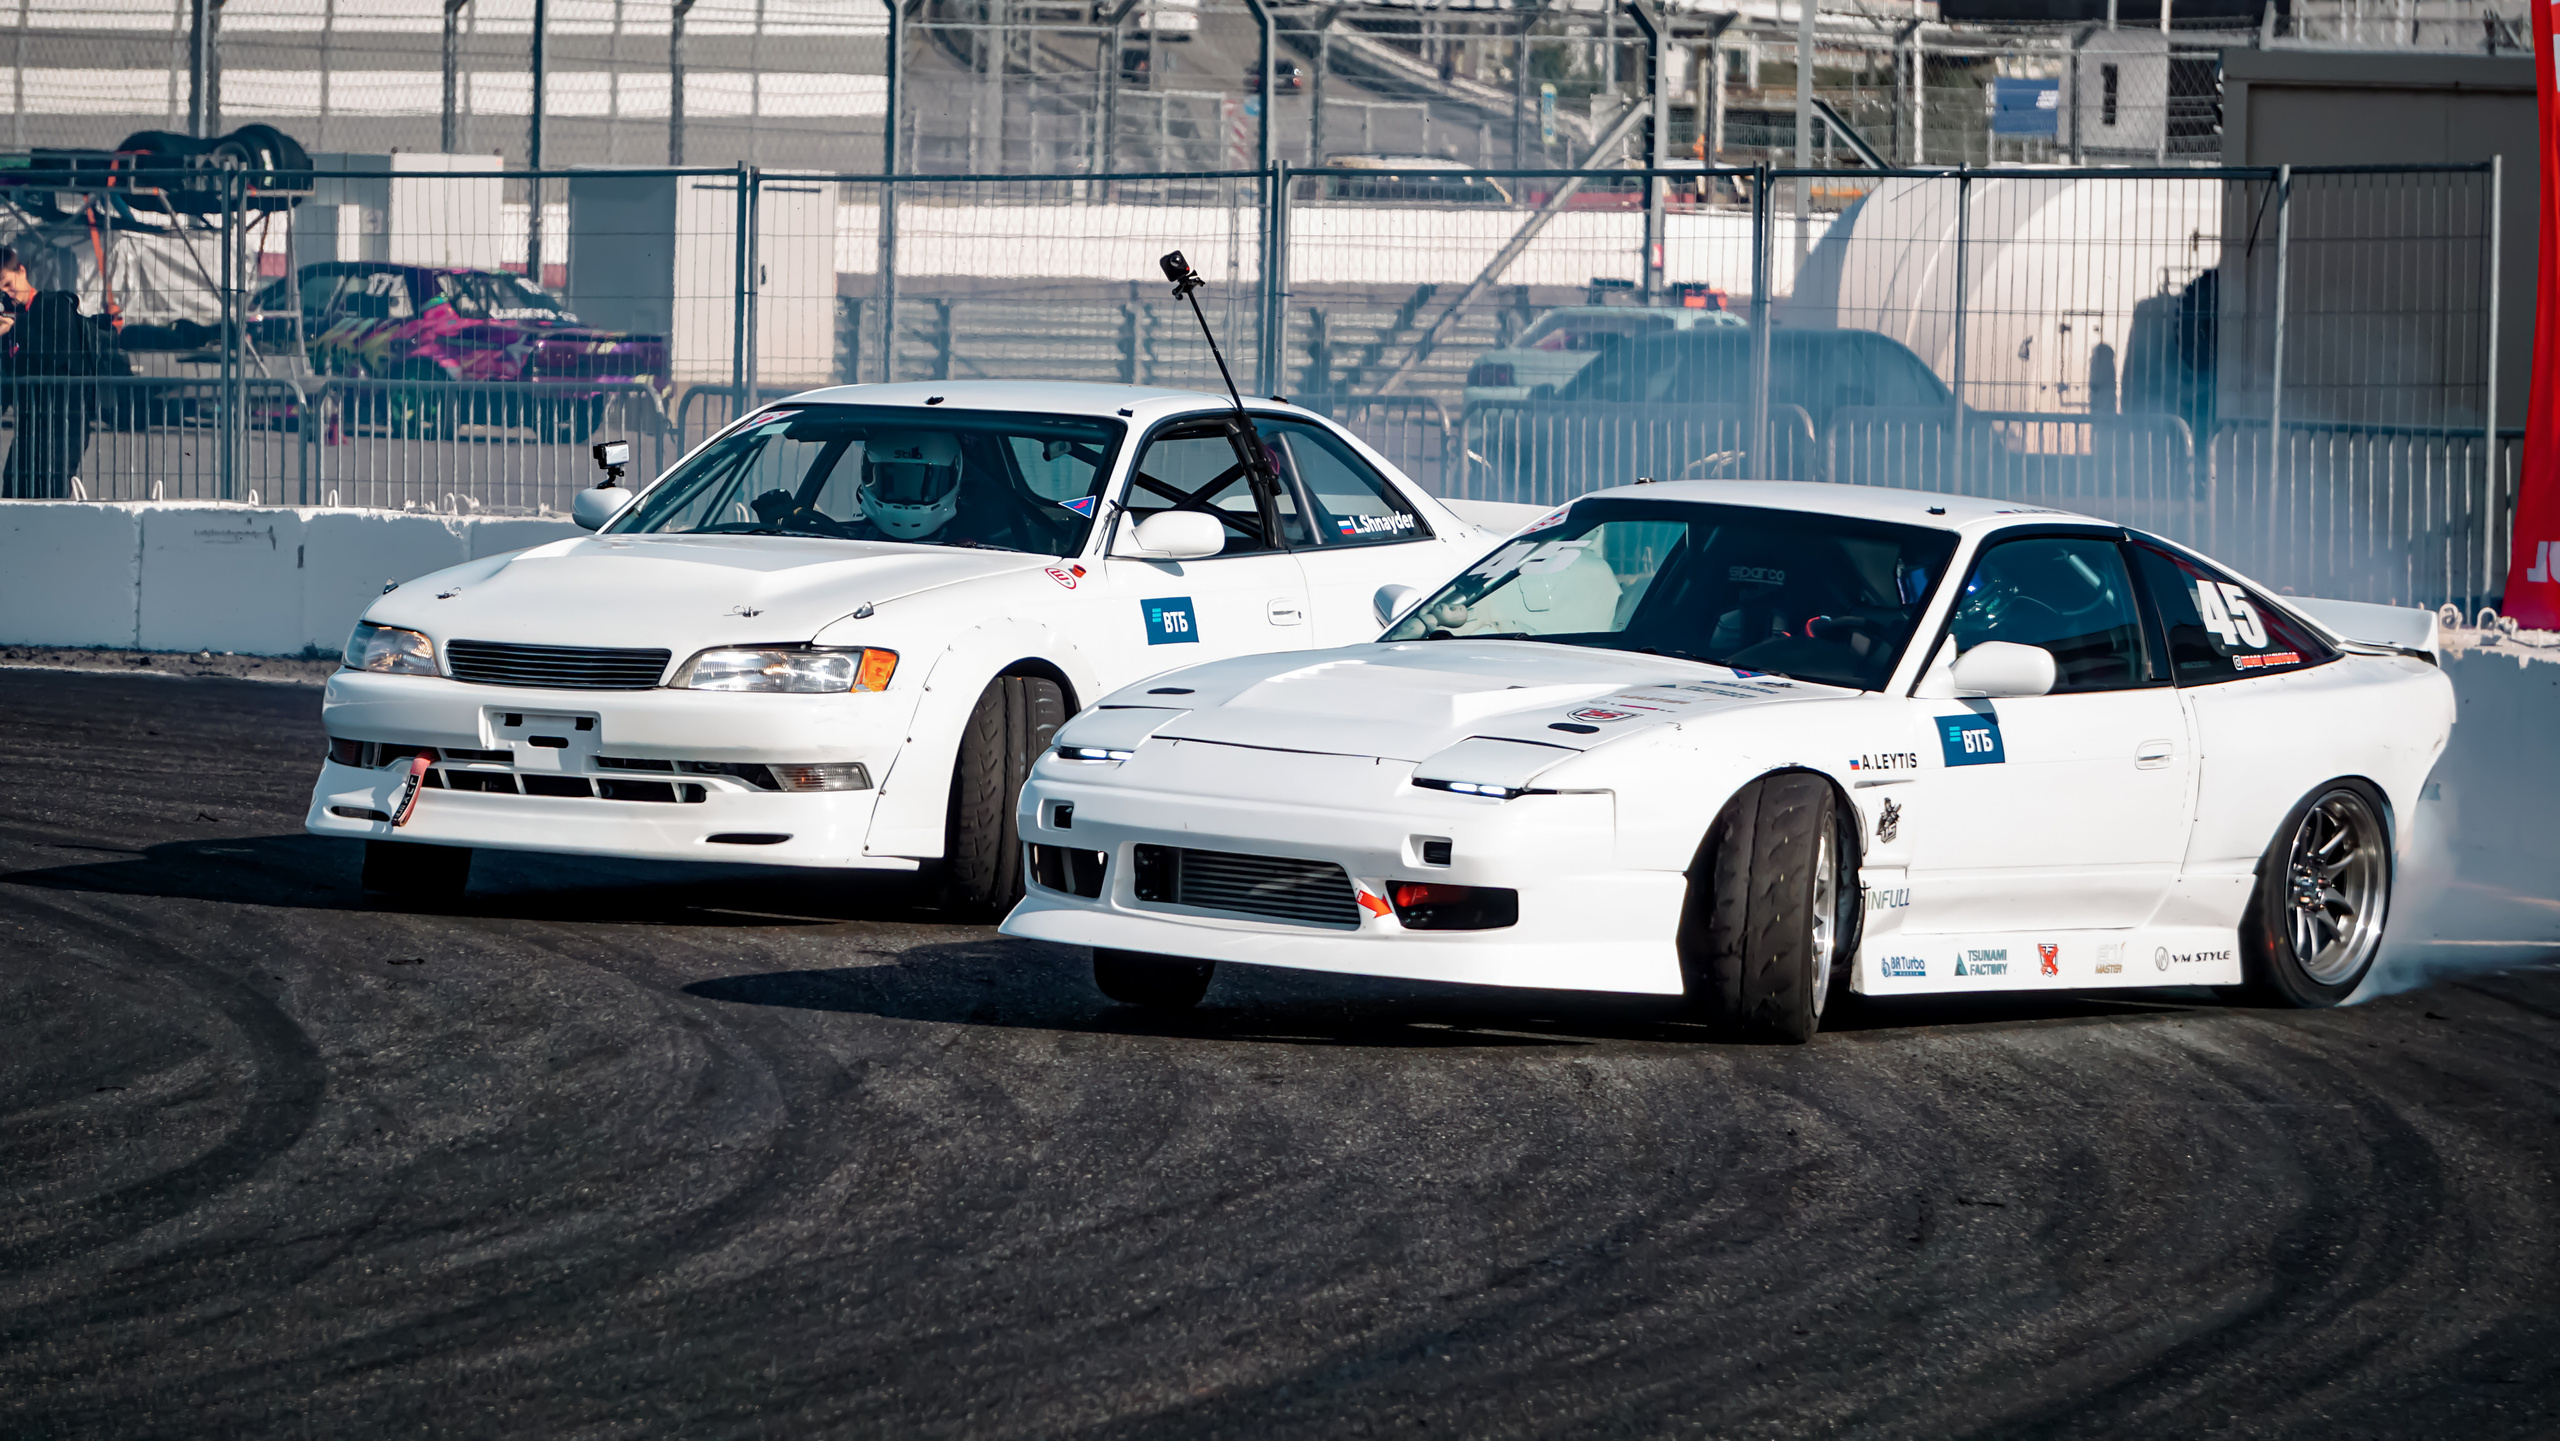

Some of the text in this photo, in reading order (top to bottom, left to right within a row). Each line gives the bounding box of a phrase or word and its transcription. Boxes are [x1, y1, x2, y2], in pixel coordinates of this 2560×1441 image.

[1349, 510, 1415, 535] L.Shnayder
[1467, 540, 1593, 579] 45
[1728, 566, 1785, 582] sparco
[1162, 611, 1189, 633] ВТБ
[2196, 579, 2269, 649] 45
[1962, 728, 1995, 754] ВТБ
[1862, 752, 1918, 770] A.LEYTIS
[1967, 949, 2007, 961] TSUNAMI
[2171, 950, 2231, 963] VM STYLE
[1970, 963, 2008, 976] FACTORY
[2095, 964, 2123, 974] MASTER
